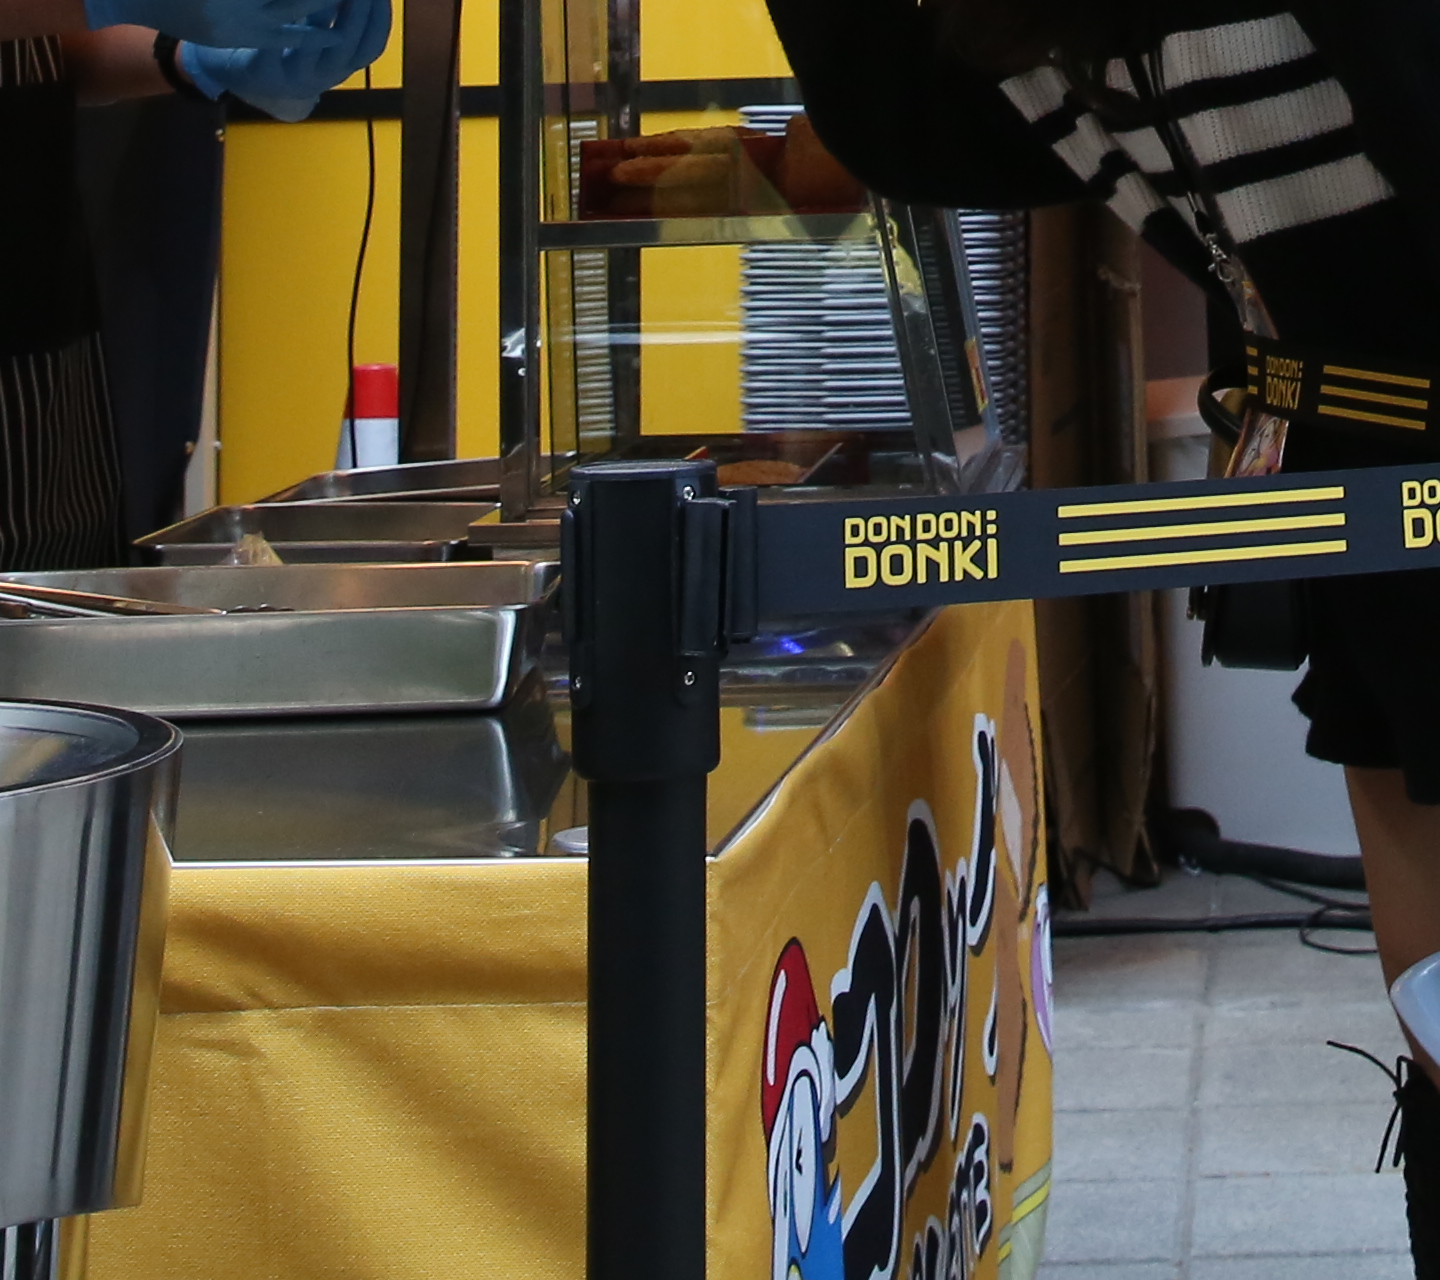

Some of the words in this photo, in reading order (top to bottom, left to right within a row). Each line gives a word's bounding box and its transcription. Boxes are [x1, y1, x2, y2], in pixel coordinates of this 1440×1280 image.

[1266, 376, 1301, 410] DONKI
[844, 514, 911, 545] DON
[844, 538, 998, 589] DONKI
